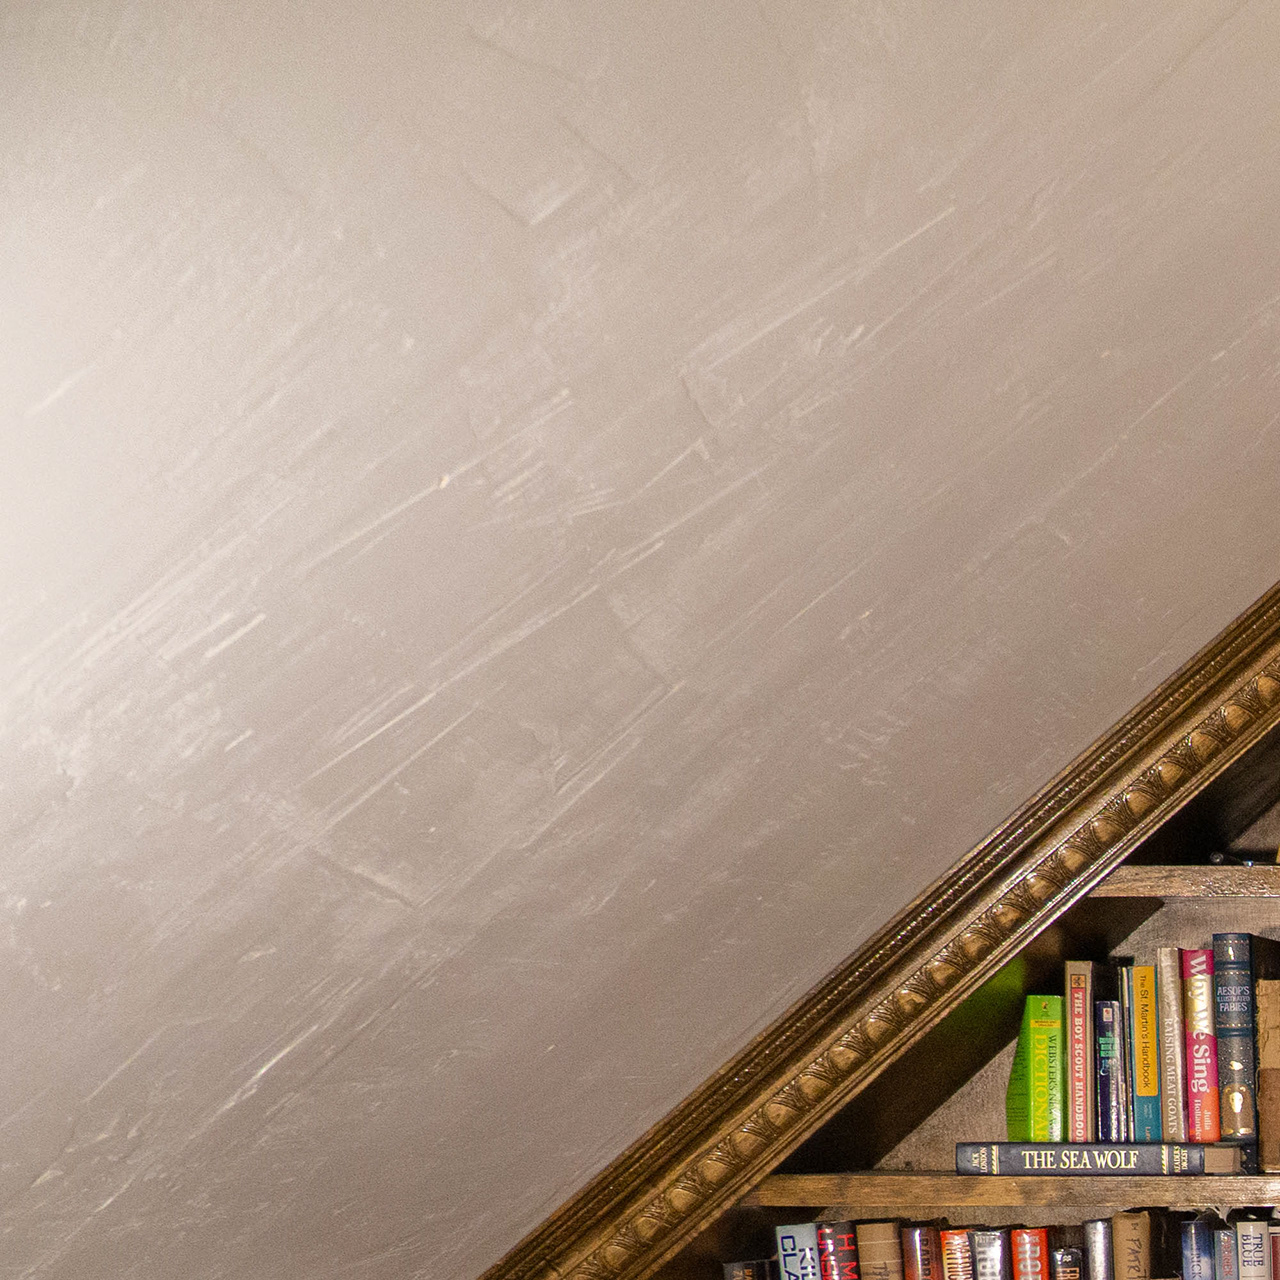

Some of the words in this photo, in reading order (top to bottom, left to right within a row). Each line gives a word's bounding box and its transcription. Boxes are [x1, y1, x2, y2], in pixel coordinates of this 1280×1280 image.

[1187, 955, 1210, 1004] Why
[1191, 1009, 1210, 1040] We
[1190, 1044, 1212, 1093] Sing
[1020, 1149, 1049, 1169] THE
[1054, 1149, 1091, 1169] SEA
[1093, 1149, 1139, 1169] WOLF
